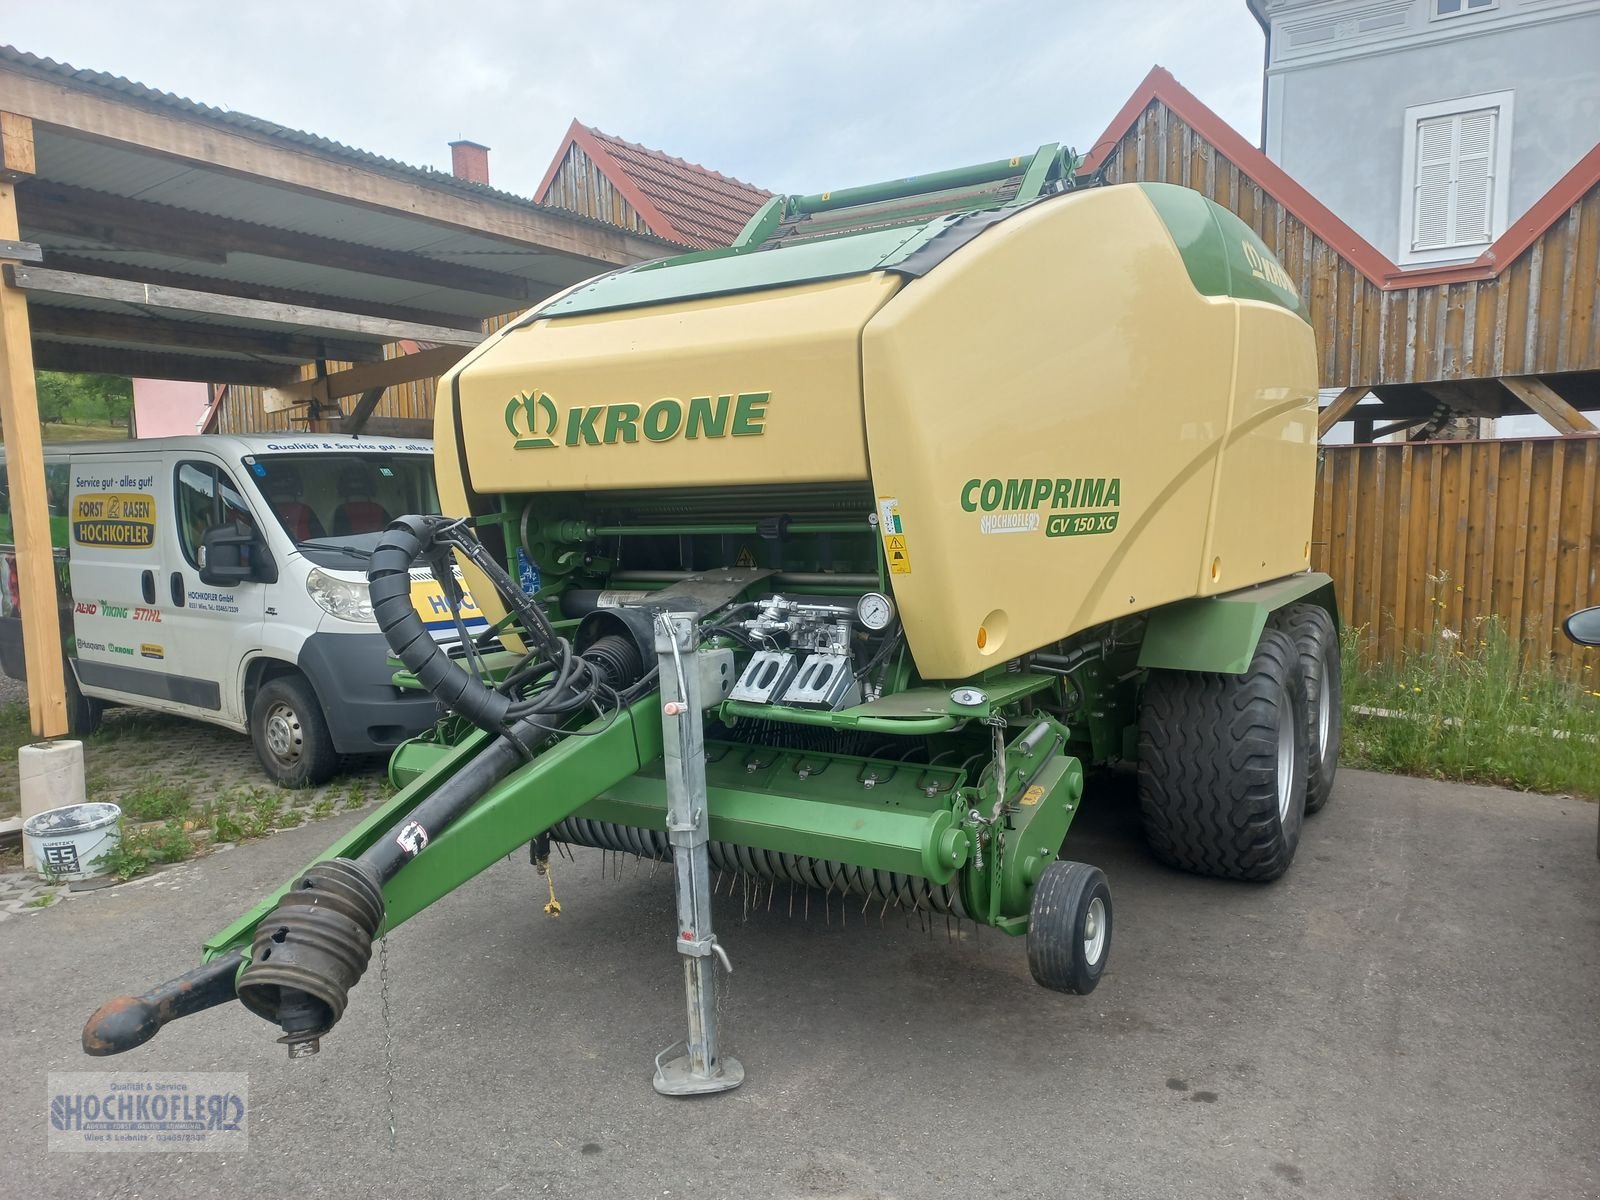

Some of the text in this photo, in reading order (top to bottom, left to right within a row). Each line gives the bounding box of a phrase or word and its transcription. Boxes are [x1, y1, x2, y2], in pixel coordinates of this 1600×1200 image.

[564, 390, 772, 447] KRONE
[267, 443, 319, 451] Qualität
[76, 476, 100, 488] Service
[101, 477, 113, 490] gut
[119, 475, 137, 487] alles
[138, 475, 153, 490] gut!
[960, 478, 1121, 513] COMPRIMA
[79, 501, 150, 518] FORST RASEN
[984, 513, 1037, 534] HOCHKOFLER
[1050, 516, 1116, 533] CV 150 XC
[79, 524, 149, 543] HOCHKOFLER
[187, 591, 234, 603] HOCHKOFLER GmbH
[102, 606, 128, 619] VIKING
[132, 607, 162, 623] STIHL
[115, 646, 134, 656] KRONE
[46, 848, 76, 864] ES
